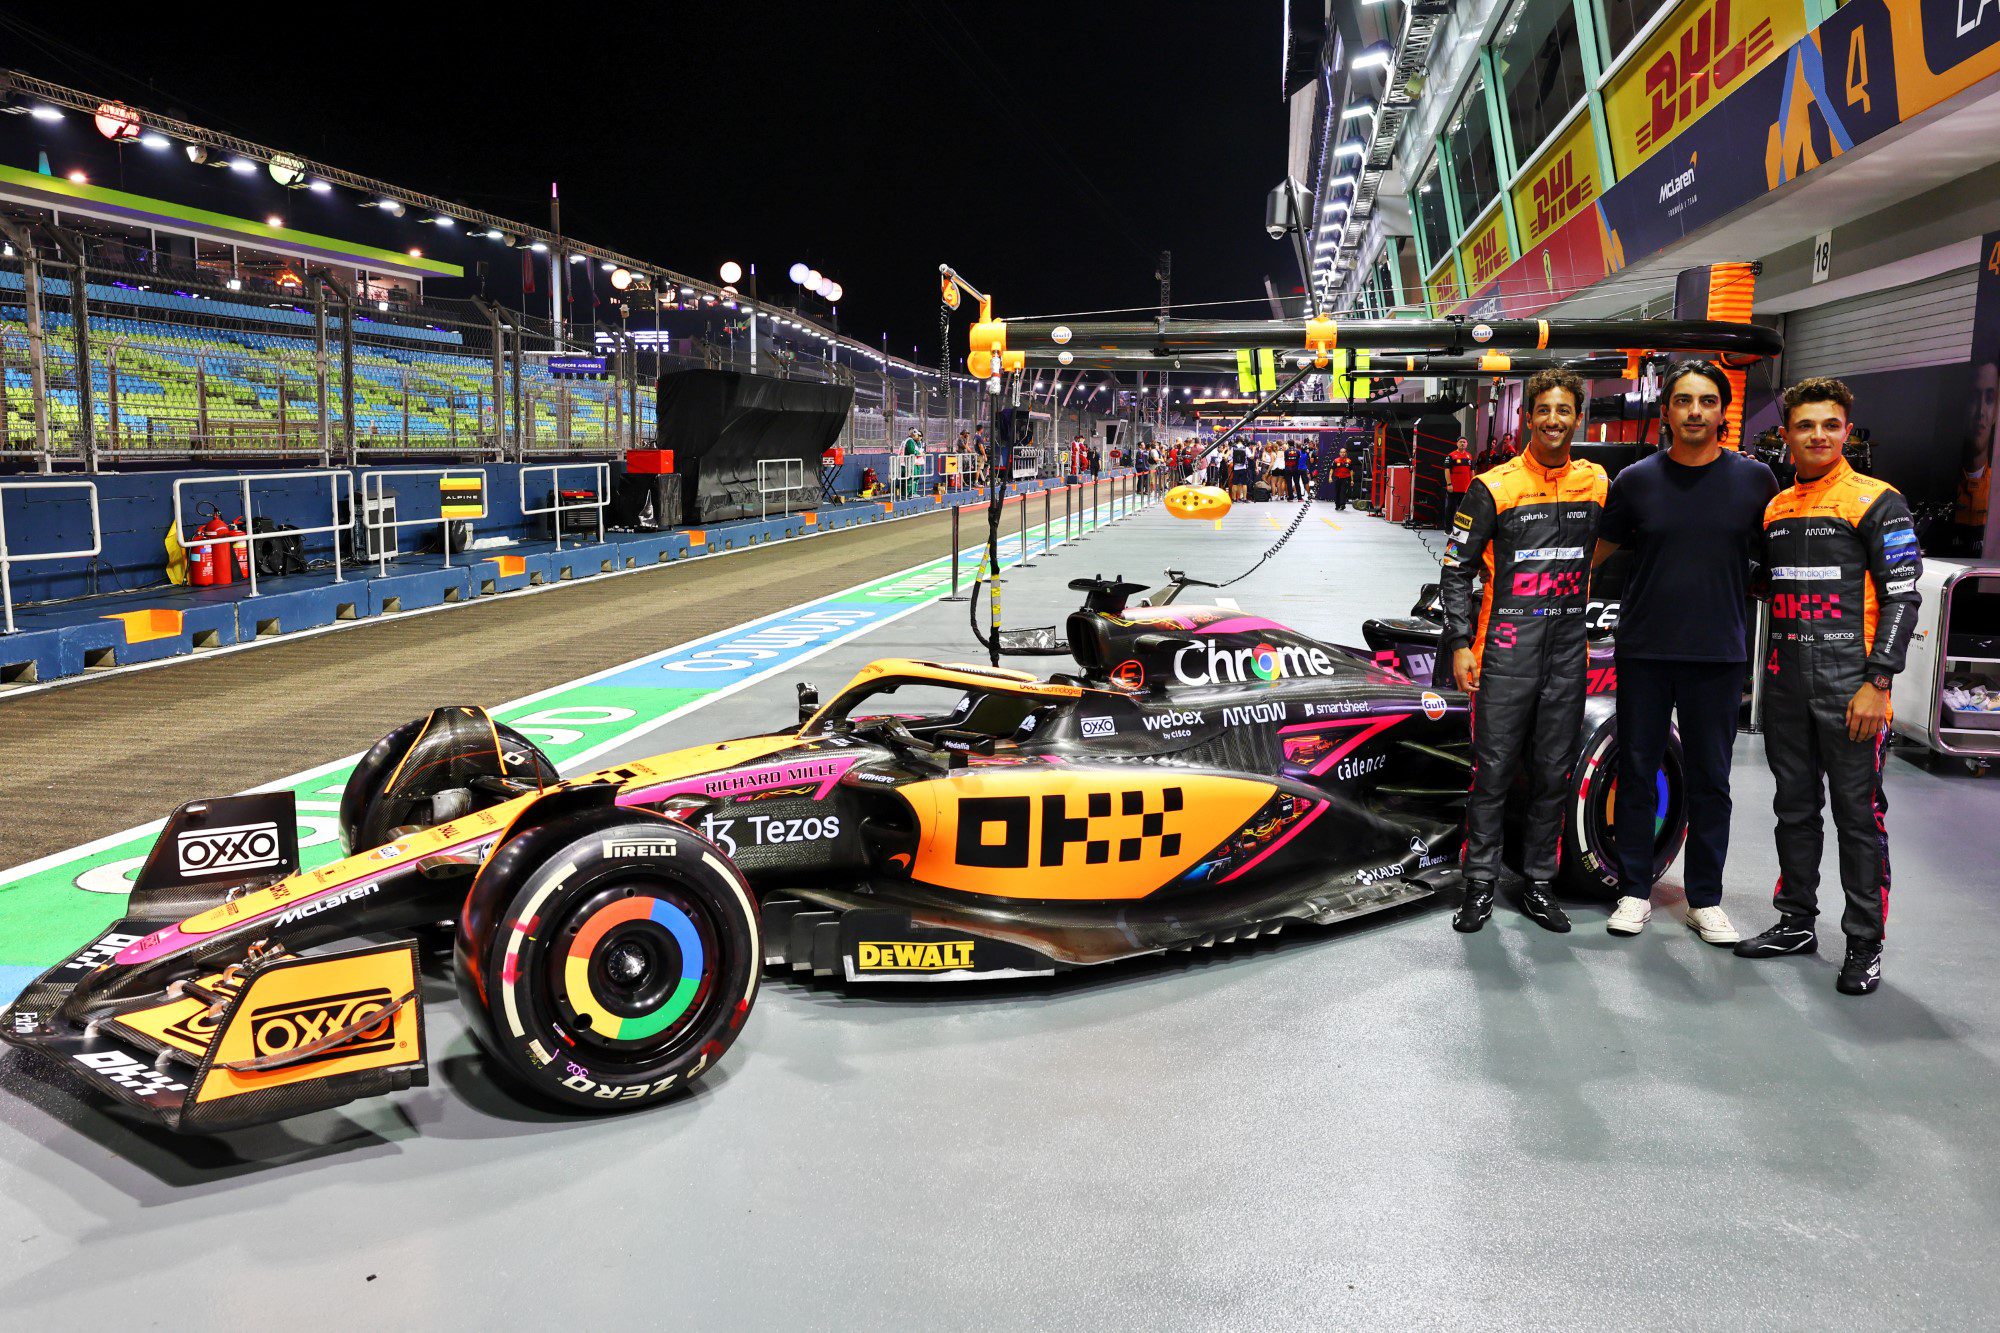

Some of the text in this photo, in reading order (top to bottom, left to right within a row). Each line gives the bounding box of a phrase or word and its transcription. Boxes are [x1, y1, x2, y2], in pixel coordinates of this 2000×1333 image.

[1646, 0, 1747, 145] DHL
[1846, 24, 1870, 113] 4
[1533, 150, 1581, 230] DHL
[1658, 168, 1695, 204] McLaren
[1687, 194, 1698, 208] TEAM
[1473, 226, 1500, 283] DHL
[1815, 242, 1829, 273] 18
[1436, 272, 1456, 315] DHL
[823, 457, 835, 465] 55
[1804, 528, 1836, 536] ARROW
[1512, 571, 1582, 597] OKX
[1786, 567, 1838, 579] Technologies
[1498, 607, 1524, 615] sparco
[1772, 593, 1842, 620] OKX
[1494, 622, 1518, 649] 3
[1824, 632, 1855, 641] sparco
[1884, 604, 1906, 654] RICHARD MILLE
[1173, 639, 1335, 686] Chrome
[1767, 648, 1781, 675] 4
[1223, 701, 1287, 728] ARROW
[1316, 700, 1370, 715] smartsheet
[1423, 700, 1446, 710] Gulf
[1083, 720, 1113, 733] OXXO
[1142, 709, 1204, 731] webex
[945, 740, 970, 750] Medallia
[1163, 729, 1191, 740] by cisco
[706, 763, 837, 794] RICHARD MILLE
[858, 773, 895, 784] vmware
[748, 815, 839, 844] Tezos
[957, 787, 1183, 869] OKX
[182, 832, 276, 868] OXXO
[603, 838, 677, 859] PIRELLI
[1372, 863, 1405, 880] KAUST
[275, 883, 380, 928] McLaren
[72, 1050, 188, 1096] OKX
[562, 1053, 708, 1100] P ZERO
